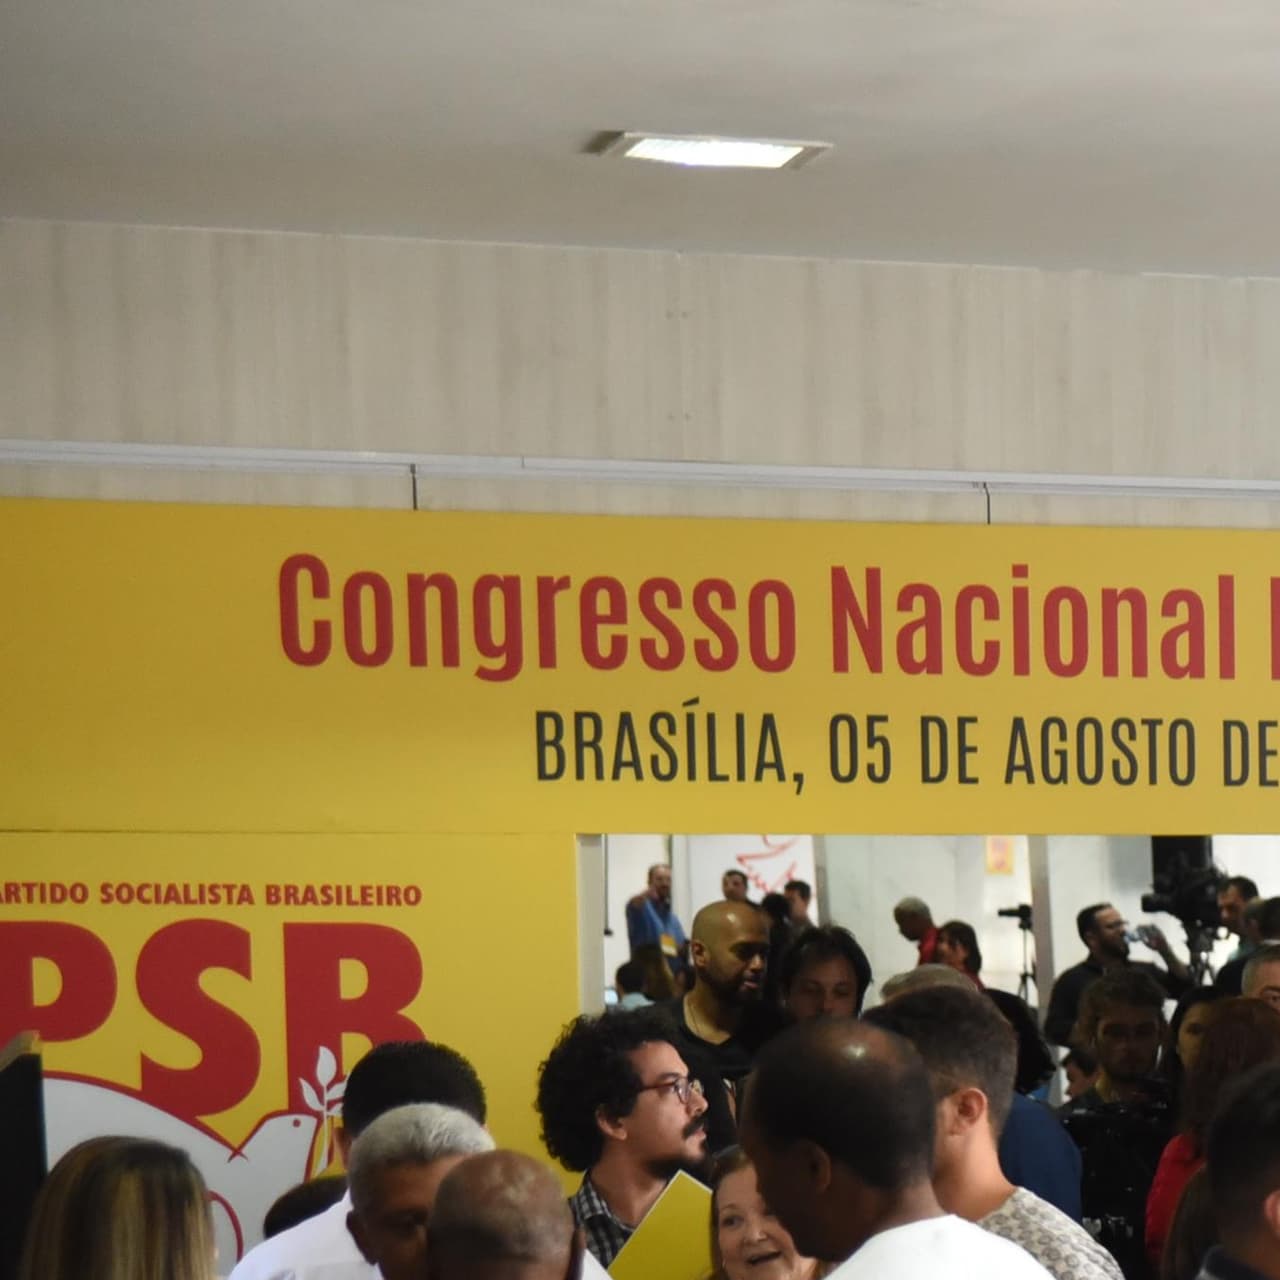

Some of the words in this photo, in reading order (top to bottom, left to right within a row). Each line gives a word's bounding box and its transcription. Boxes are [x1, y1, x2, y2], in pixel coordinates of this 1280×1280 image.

[279, 553, 797, 682] Congresso
[830, 564, 1235, 679] Nacional
[535, 696, 804, 795] BRASÍLIA,
[829, 713, 892, 784] 05
[920, 715, 979, 785] DE
[1004, 716, 1196, 787] AGOSTO
[1222, 719, 1279, 788] DE
[0, 882, 89, 905] RTIDO
[99, 883, 255, 906] SOCIALISTA
[265, 884, 423, 907] BRASILEIRO
[0, 918, 427, 1118] PSB
